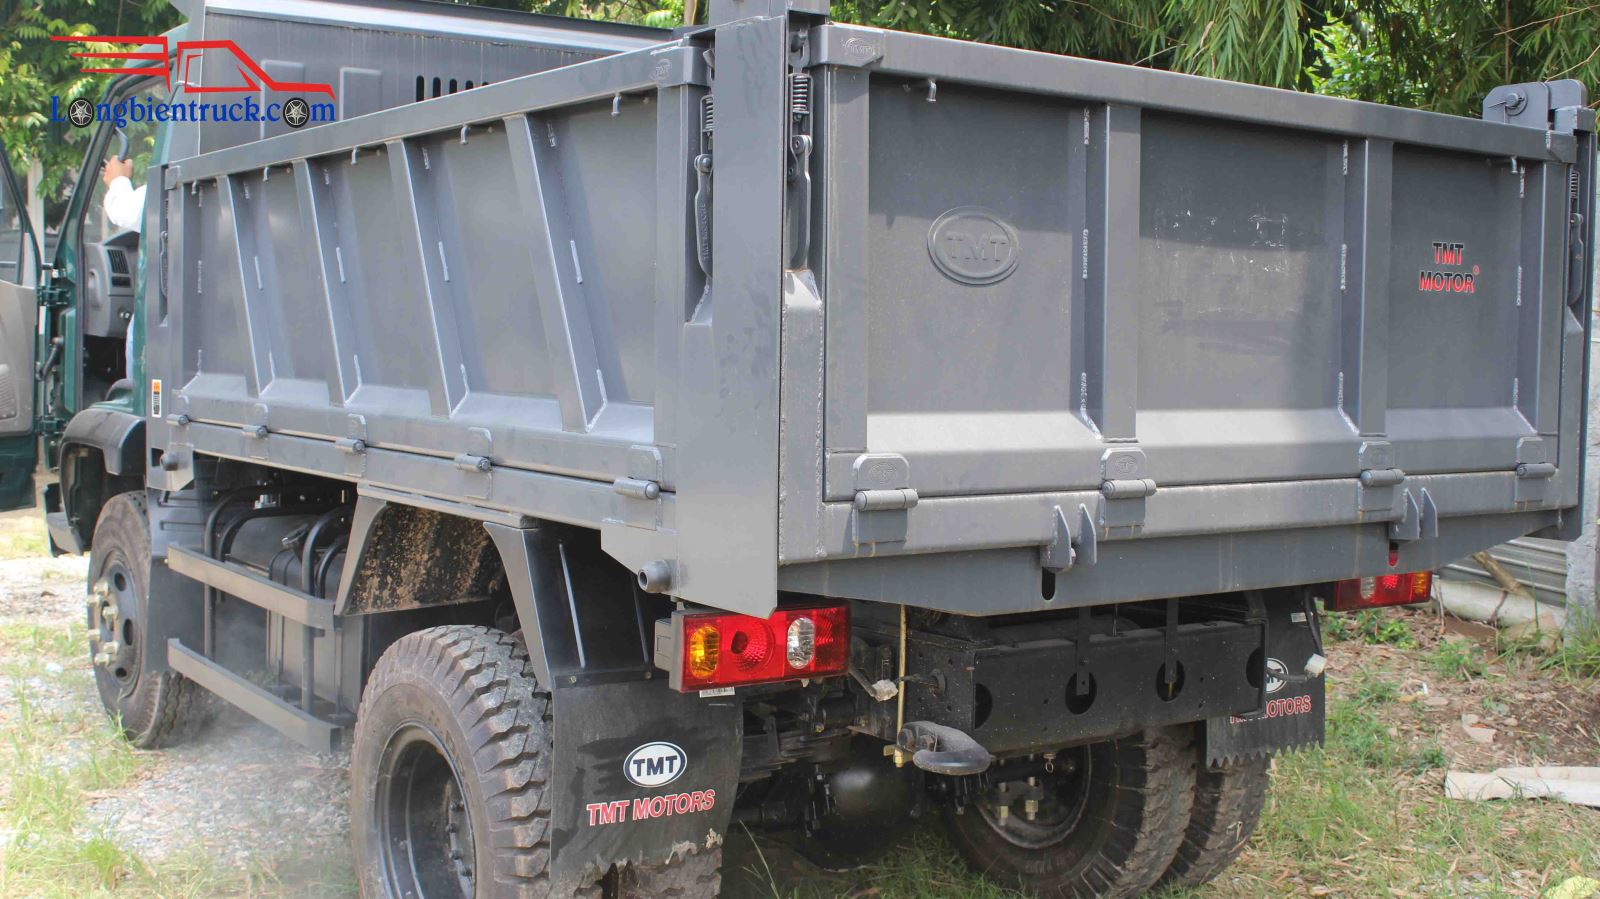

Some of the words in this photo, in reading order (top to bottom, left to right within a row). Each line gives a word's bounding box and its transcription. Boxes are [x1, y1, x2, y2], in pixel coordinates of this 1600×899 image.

[1432, 242, 1464, 265] TMT
[1419, 270, 1475, 293] MOTOR
[1265, 695, 1312, 719] OTORS
[632, 755, 678, 777] TMT
[586, 800, 630, 826] TMT
[632, 789, 716, 821] MOTORS
